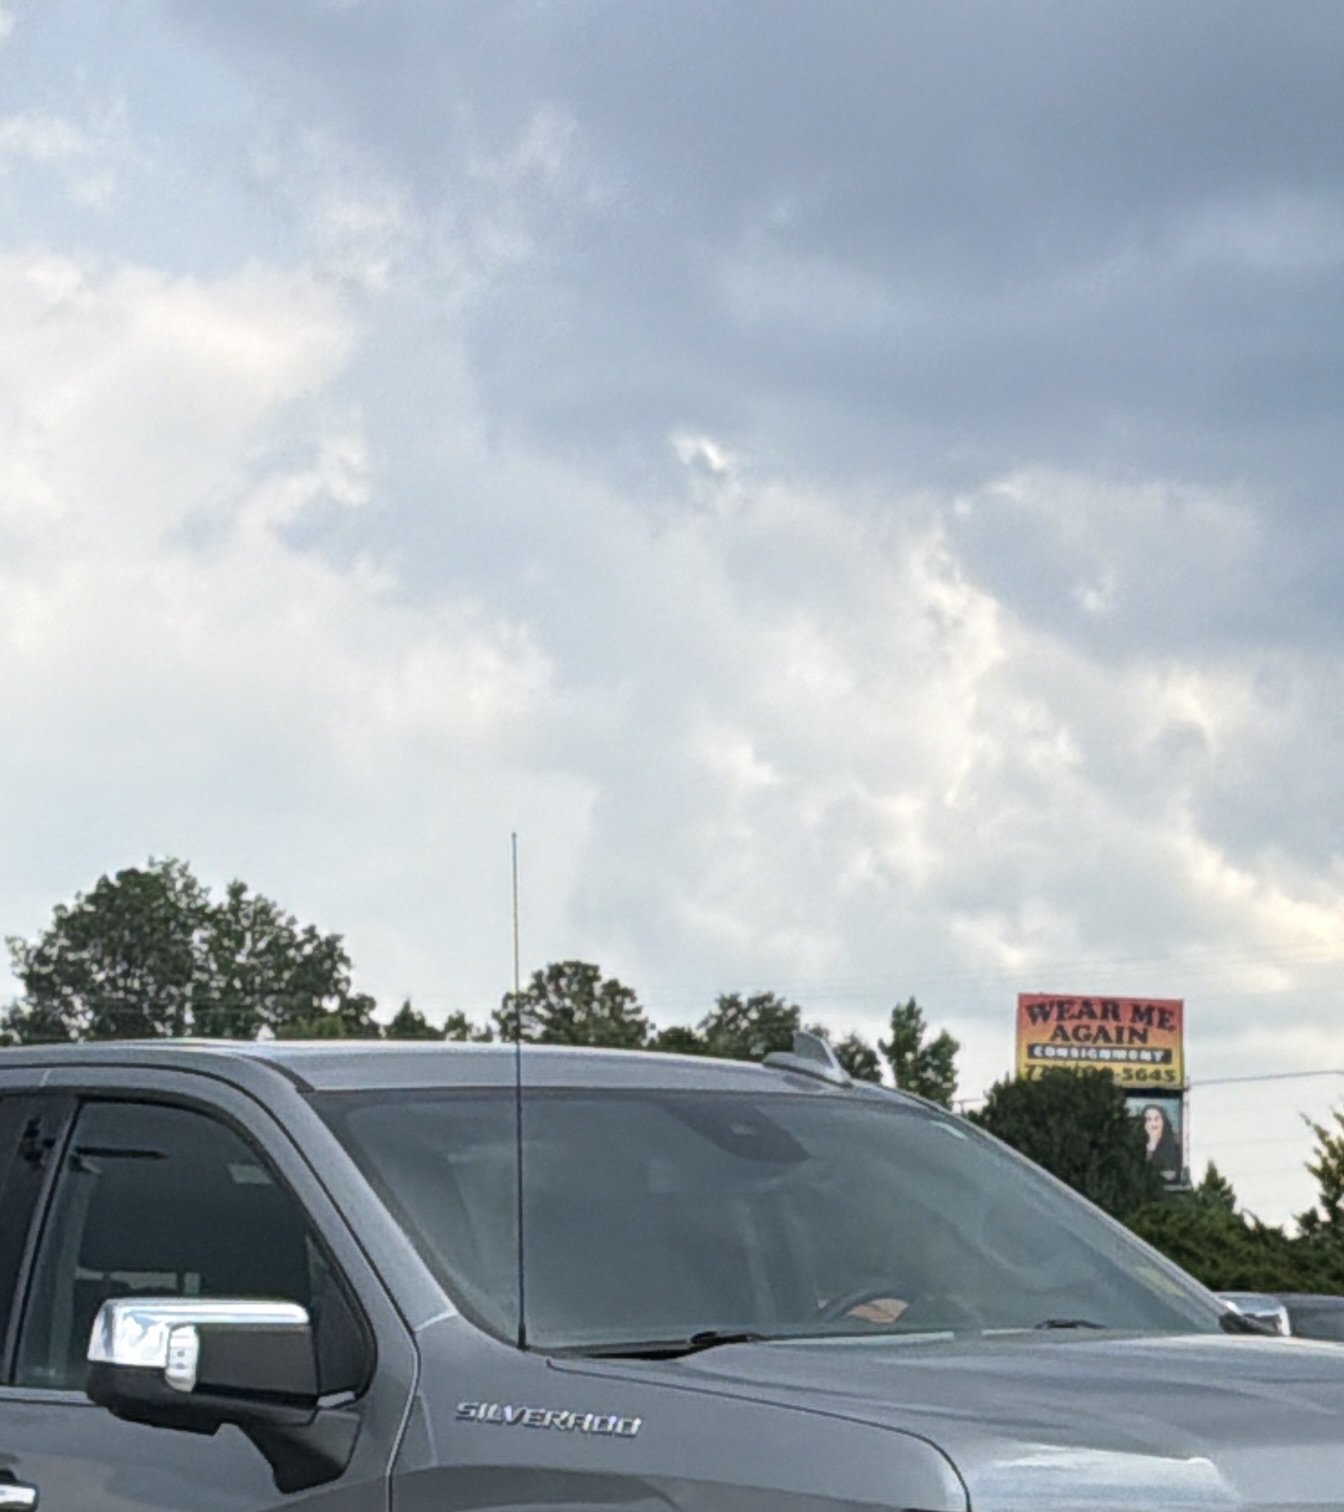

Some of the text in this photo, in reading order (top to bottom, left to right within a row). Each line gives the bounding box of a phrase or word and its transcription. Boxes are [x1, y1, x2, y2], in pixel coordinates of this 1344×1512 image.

[1024, 999, 1175, 1031] WEAR ME
[1050, 1025, 1148, 1044] AGAIN
[1034, 1046, 1164, 1062] CONSIGNMENT
[456, 1401, 642, 1437] SILVERADO
